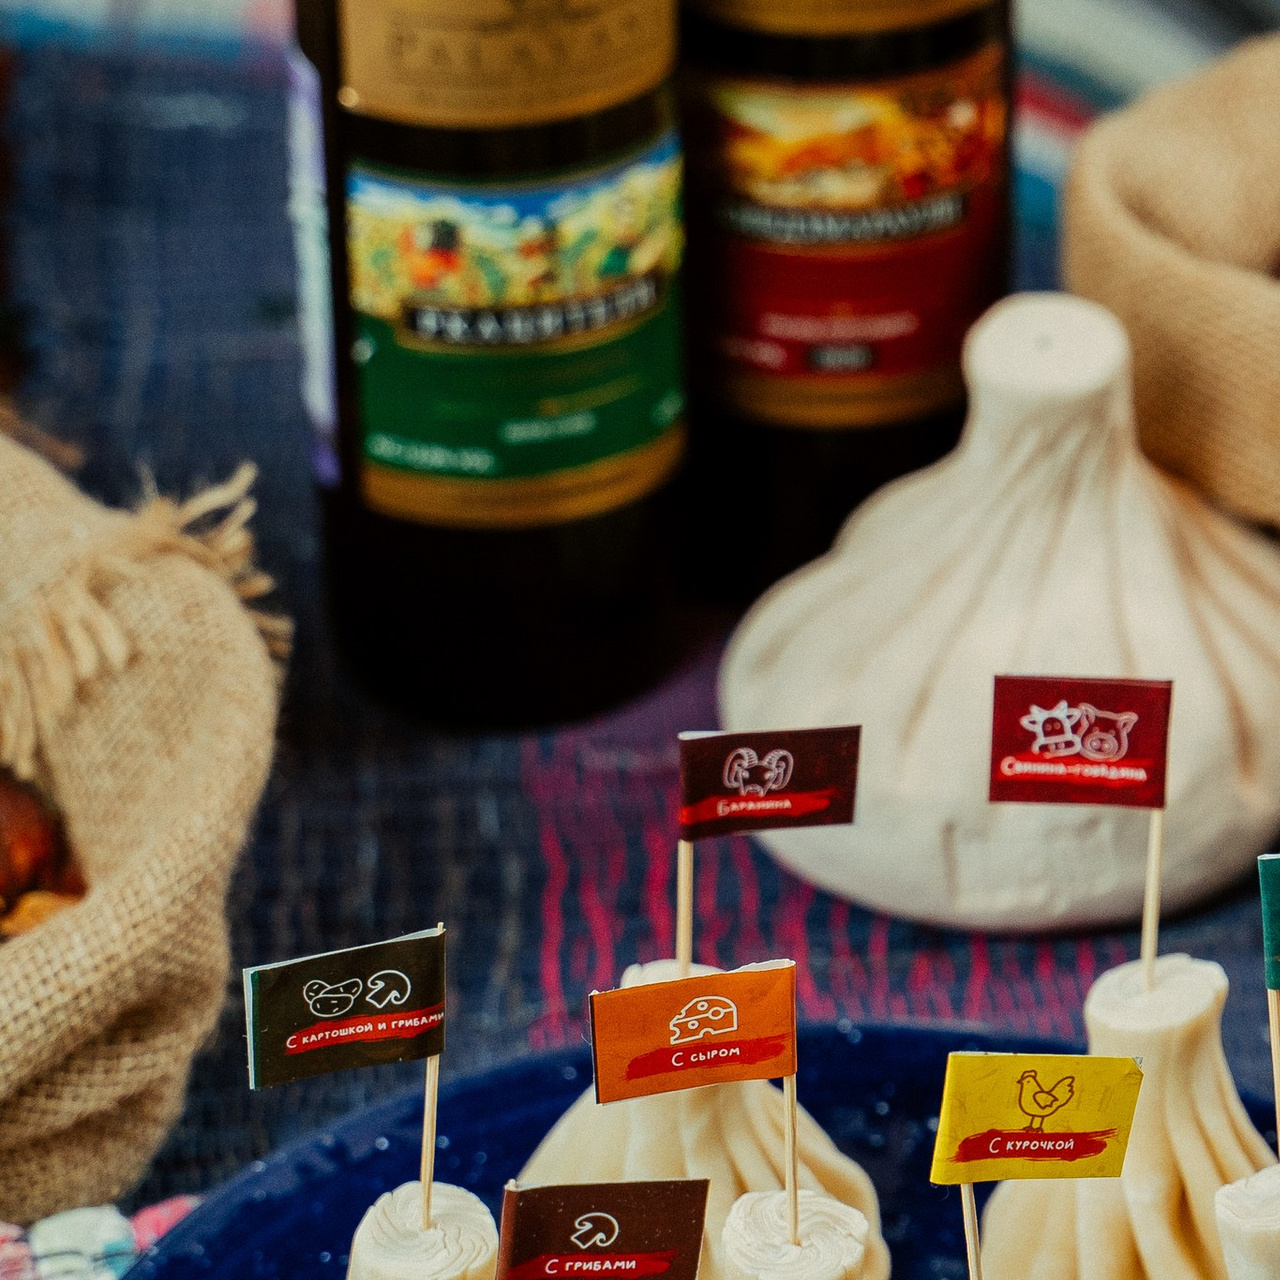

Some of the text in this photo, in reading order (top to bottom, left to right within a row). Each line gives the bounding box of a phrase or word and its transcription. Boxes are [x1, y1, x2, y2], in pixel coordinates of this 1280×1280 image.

[286, 1035, 298, 1050] С
[301, 1022, 374, 1046] КАРТОШКОЙ
[671, 1051, 684, 1067] С
[988, 1136, 1075, 1154] С КУРОЧКОЙ
[544, 1258, 637, 1275] С ГРИБАМИ
